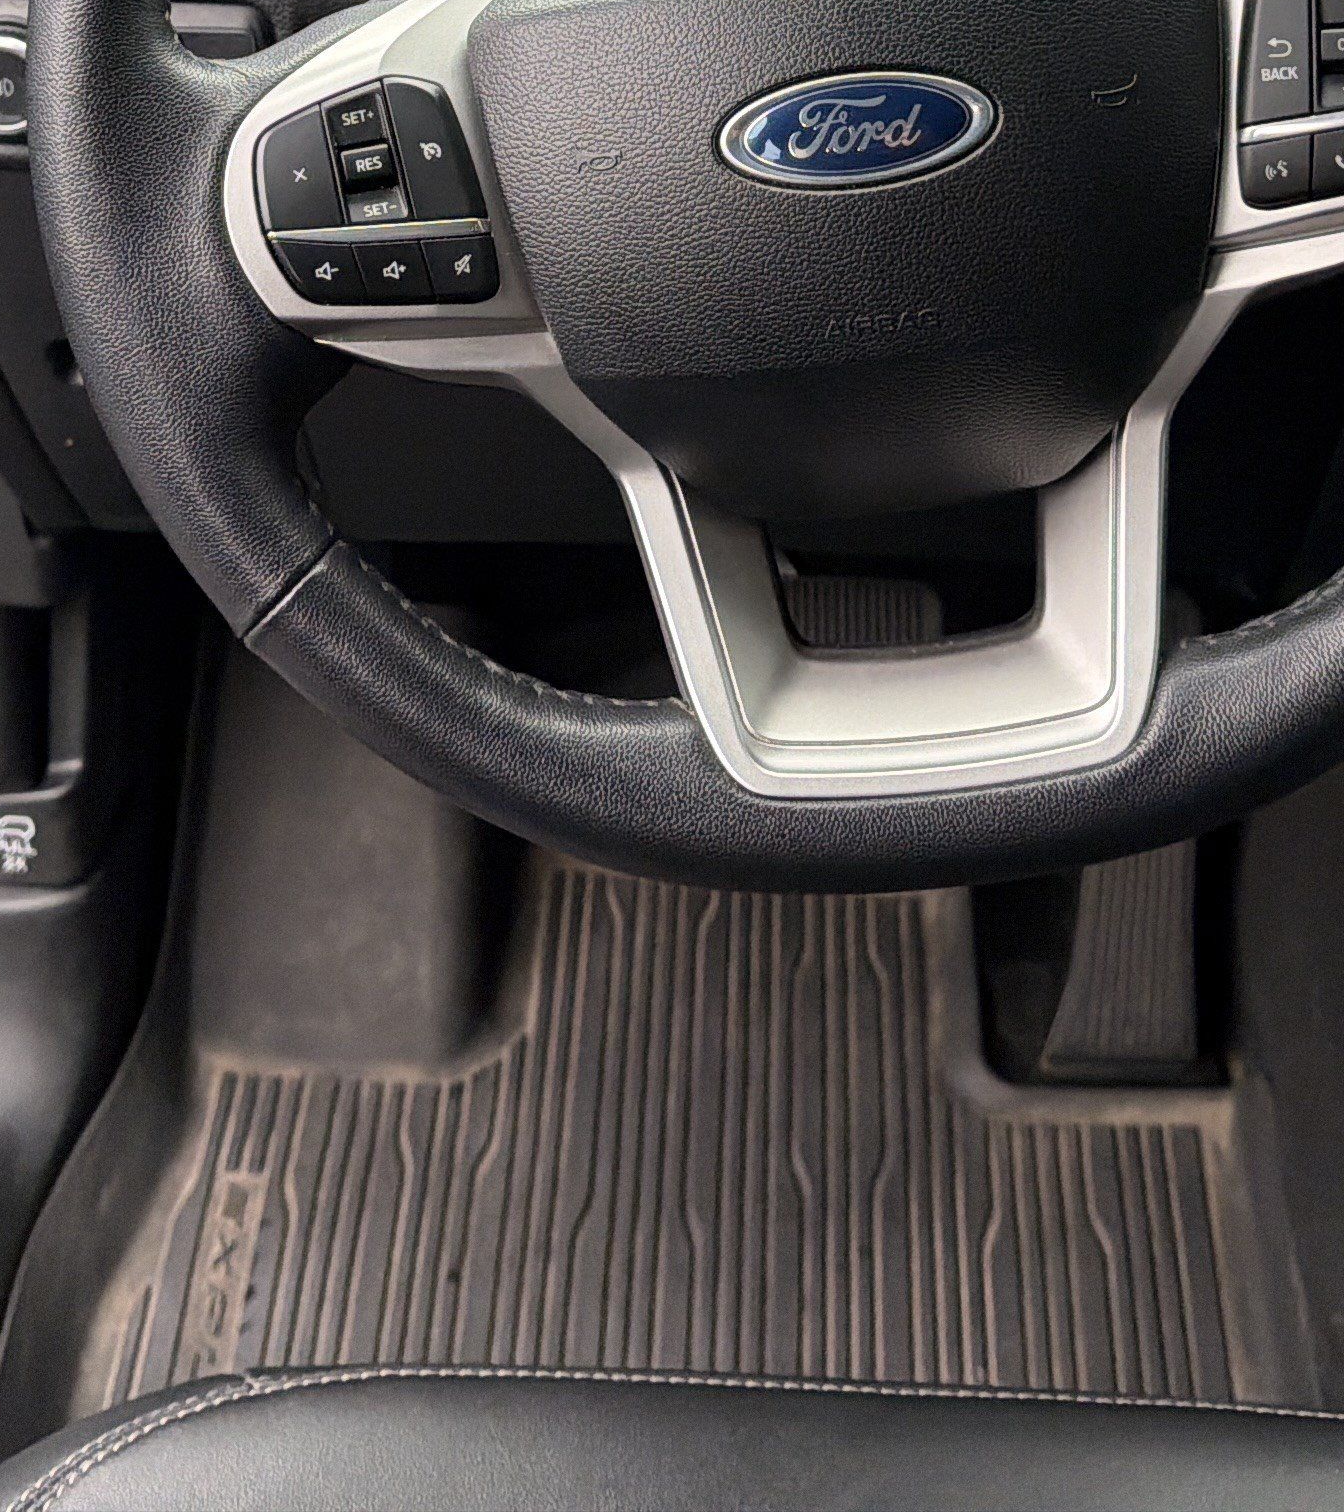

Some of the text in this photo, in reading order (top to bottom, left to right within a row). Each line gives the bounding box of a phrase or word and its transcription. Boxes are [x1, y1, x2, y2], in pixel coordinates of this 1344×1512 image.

[1261, 66, 1298, 82] BACK
[787, 94, 925, 160] Ford
[356, 157, 383, 173] RES
